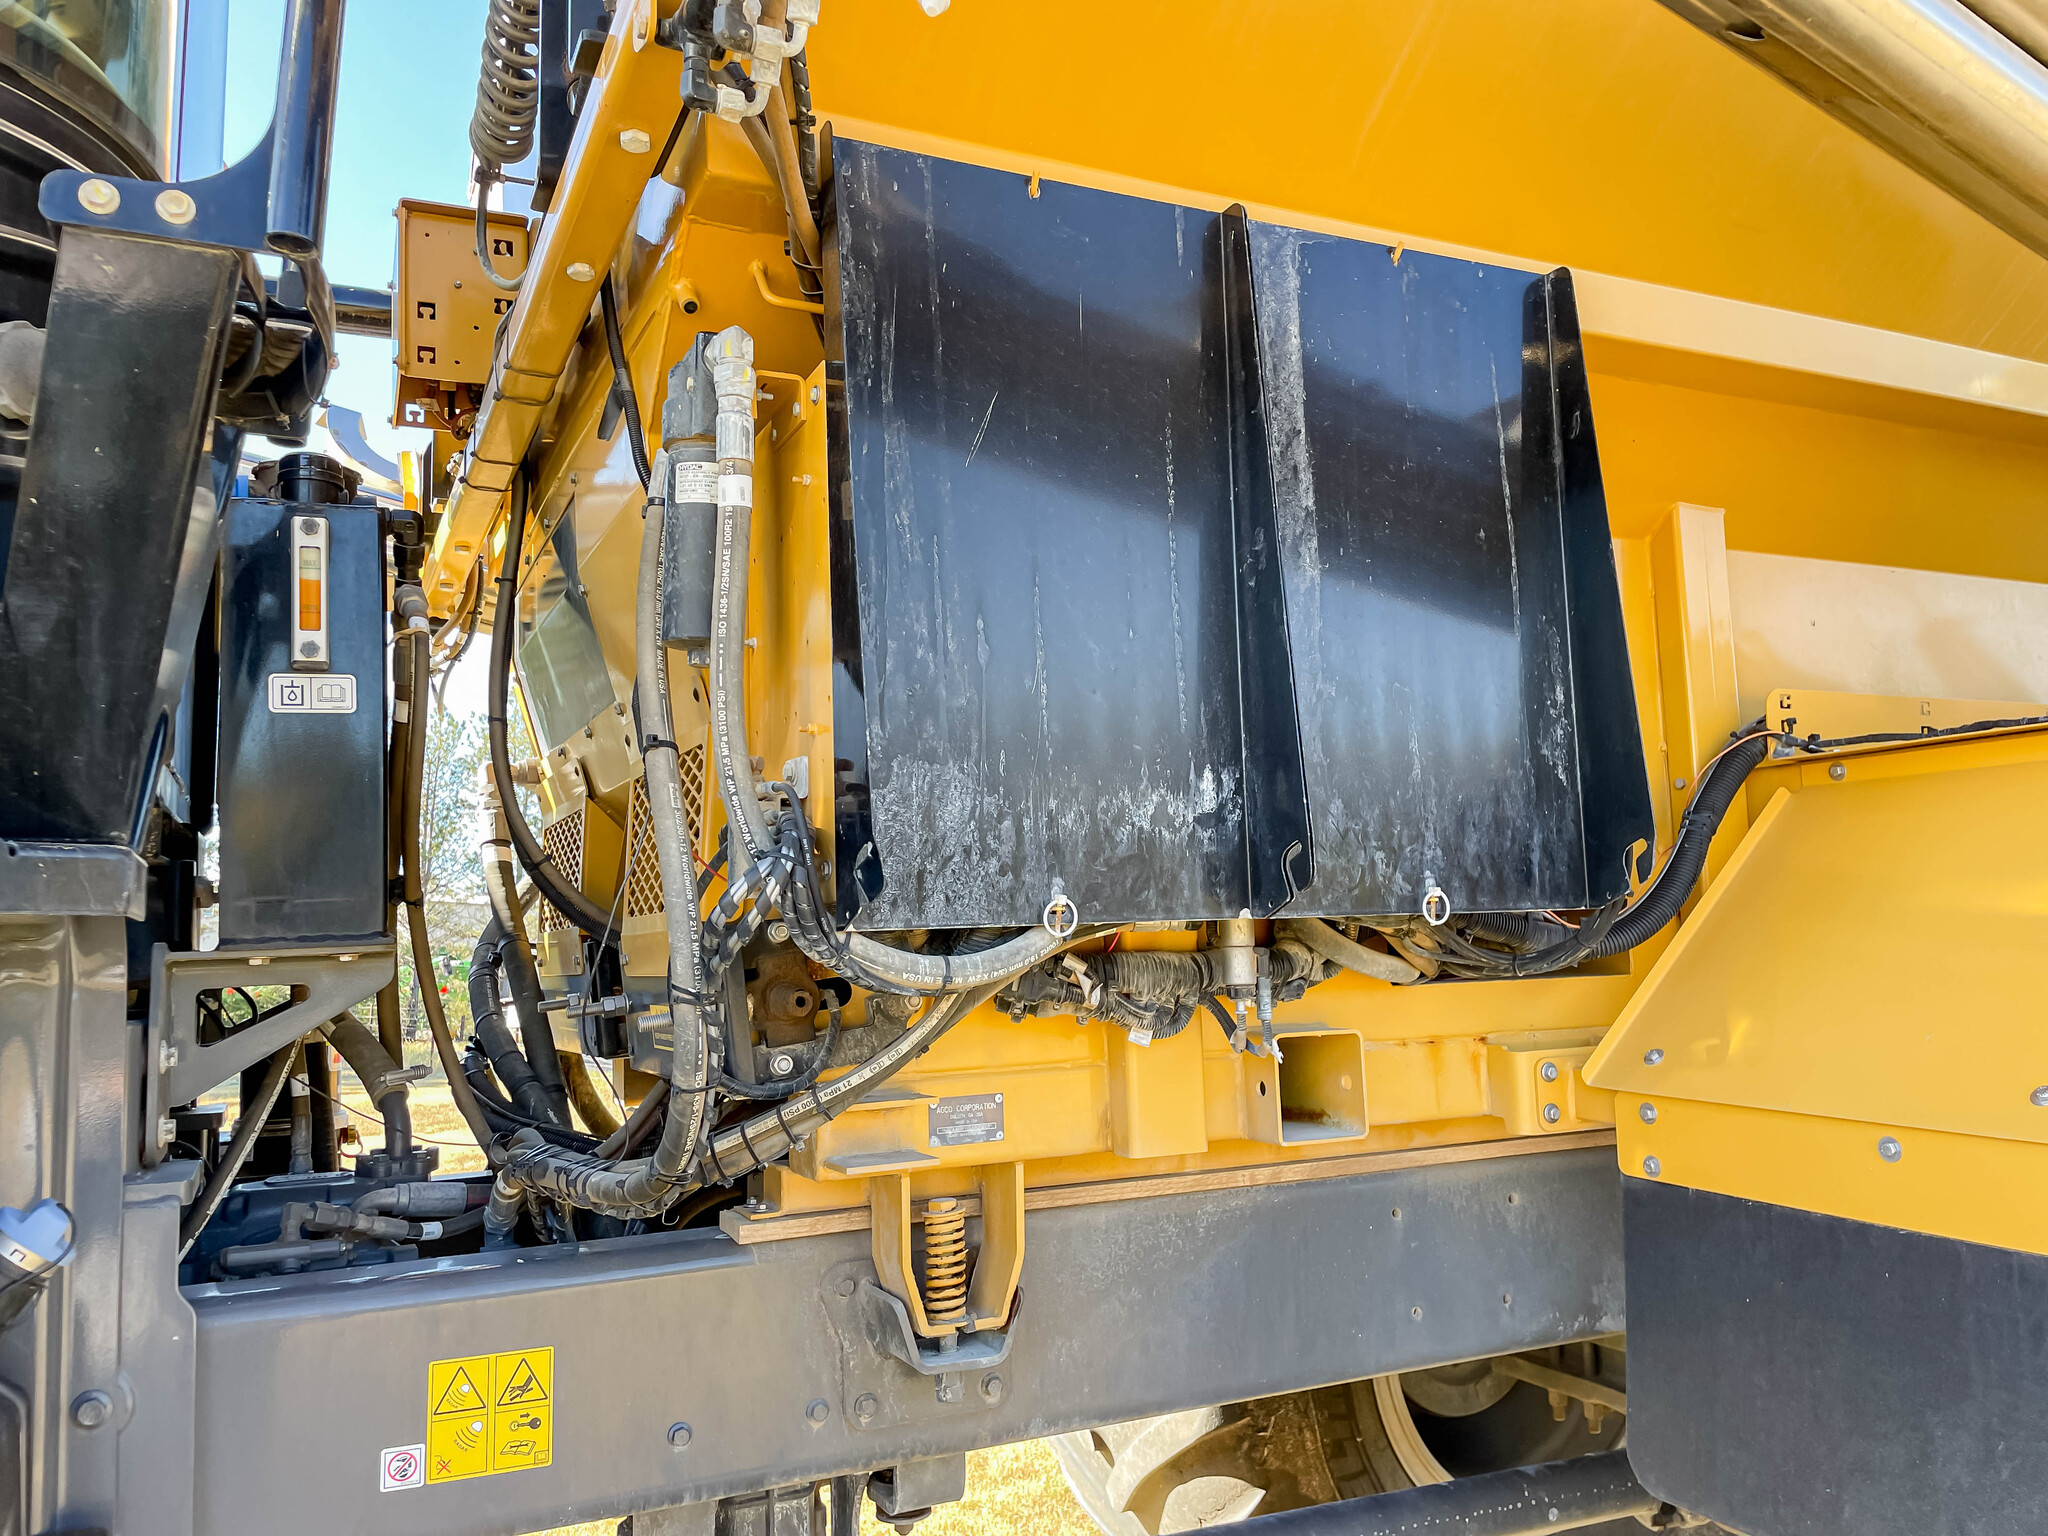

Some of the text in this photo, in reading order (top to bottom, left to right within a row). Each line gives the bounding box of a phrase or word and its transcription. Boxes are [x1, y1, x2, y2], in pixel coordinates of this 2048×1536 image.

[718, 461, 735, 637] ISO 1436-1/2SN/SAE 100R2 19 3/4
[656, 649, 664, 669] MADE
[658, 679, 666, 694] USA
[717, 690, 727, 709] PSI)
[718, 710, 728, 735] (3100
[720, 736, 730, 756] MPa
[726, 777, 737, 795] WP
[730, 795, 753, 843] Worldwide
[747, 842, 759, 856] 12
[681, 854, 694, 900] Worldwide
[687, 902, 697, 919] WP
[691, 942, 700, 963] MPa
[1024, 954, 1039, 967] 19,0
[990, 967, 1008, 979] (3/4)
[1008, 962, 1023, 972] mm
[902, 971, 923, 983] USA
[923, 976, 935, 984] IN
[967, 974, 981, 983] 2W
[694, 1071, 703, 1088] ISO
[783, 1080, 853, 1119] 21 MPa (000 PSI)
[936, 1103, 996, 1114] AGCO CORPORATION
[446, 1398, 458, 1409] RADAR
[453, 1438, 468, 1451] RADAR
